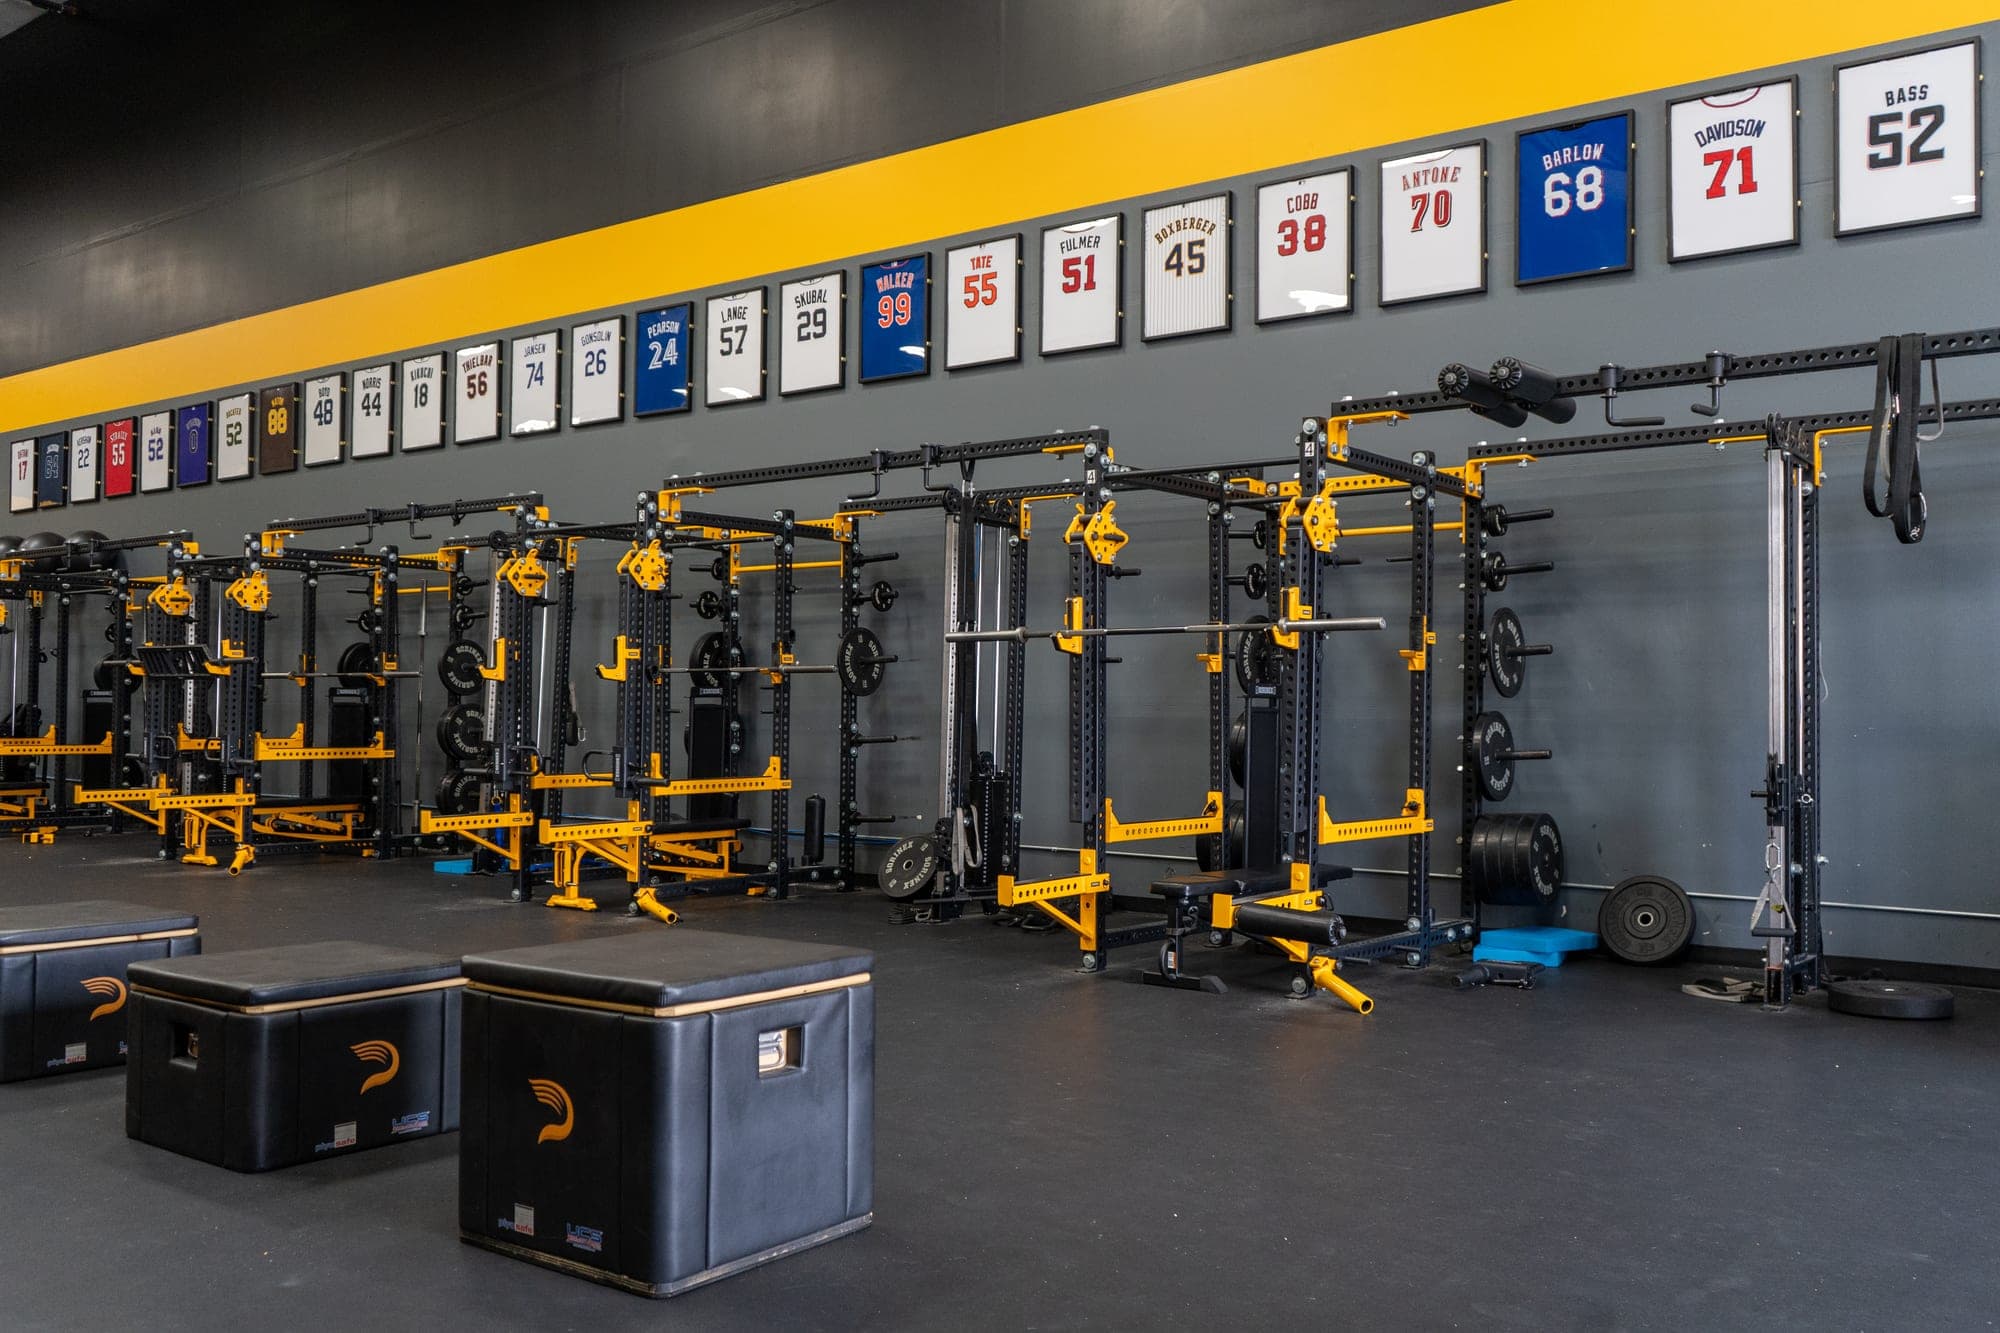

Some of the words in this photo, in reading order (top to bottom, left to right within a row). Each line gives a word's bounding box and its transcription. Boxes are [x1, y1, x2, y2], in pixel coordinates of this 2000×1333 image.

[1884, 84, 1929, 107] BASS
[1694, 118, 1766, 148] DAVIDSON
[1867, 104, 1946, 171] 52
[1543, 143, 1604, 171] BARLOW
[1402, 166, 1461, 192] ANTONE
[1704, 146, 1758, 200] 71
[1286, 193, 1318, 214] COBB
[1544, 166, 1605, 218] 68
[1410, 190, 1454, 232] 70
[1060, 235, 1100, 254] FULMER
[1154, 216, 1217, 245] BOXBERGER
[1277, 214, 1326, 257] 38
[970, 255, 993, 270] TATE
[1164, 238, 1206, 278] 45
[876, 272, 914, 292] WALKER
[1062, 254, 1096, 294] 51
[794, 288, 828, 309] SKUBAL
[964, 272, 998, 308] 55
[720, 306, 748, 323] LANGE
[878, 292, 912, 328] 99
[581, 331, 612, 346] GONSOLIN
[648, 320, 680, 338] PEARSON
[797, 308, 826, 342] 29
[524, 344, 546, 358] JANSEN
[648, 338, 678, 370] 24
[720, 324, 748, 356] 57
[410, 367, 434, 381] KIKUCHI
[462, 354, 493, 374] THIELBAR
[526, 361, 544, 389] 74
[584, 348, 607, 377] 26
[362, 376, 382, 390] NORRIS
[414, 382, 429, 408] 18
[466, 370, 488, 400] 56
[313, 398, 333, 426] 48
[361, 392, 381, 416] 44
[226, 421, 242, 447] 52
[268, 407, 288, 435] 88
[78, 448, 90, 469] 22
[112, 442, 125, 466] 55
[148, 438, 164, 461] 52
[19, 460, 28, 480] 17
[845, 643, 857, 683] SORINEX
[869, 641, 880, 680] SORNEX
[885, 841, 914, 874] SORINEX
[903, 857, 932, 890] SORINEX
[567, 1222, 602, 1243] UCS
